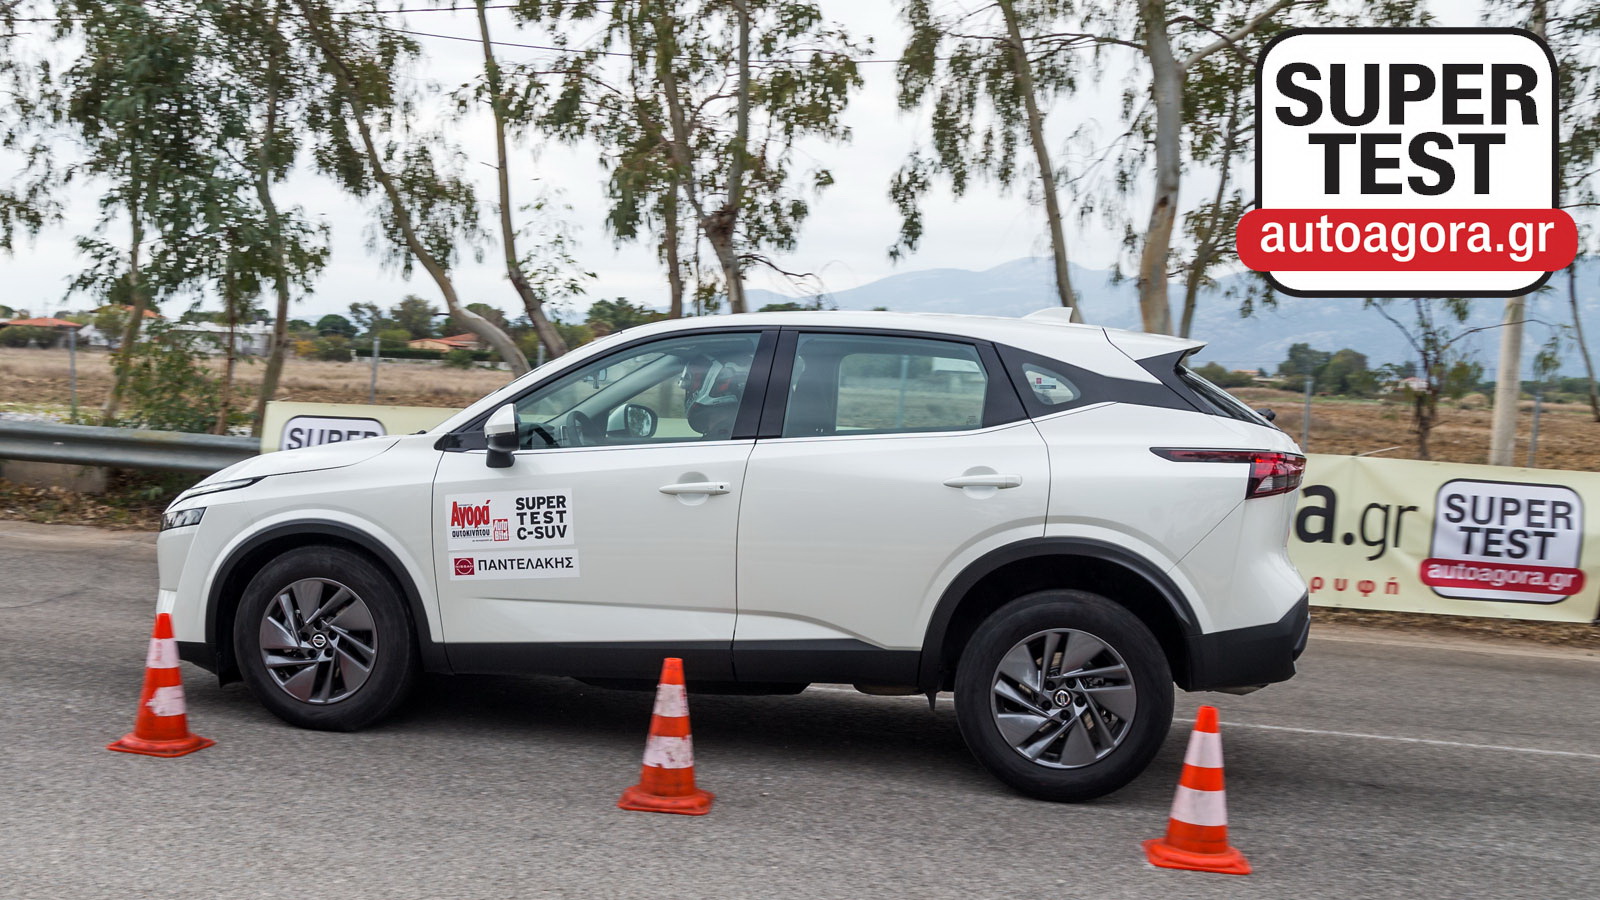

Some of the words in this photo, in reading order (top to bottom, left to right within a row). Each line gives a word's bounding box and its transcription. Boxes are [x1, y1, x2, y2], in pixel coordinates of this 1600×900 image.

[288, 427, 379, 450] SUP
[515, 496, 567, 511] SUPER
[1445, 493, 1573, 530] SUPER
[517, 510, 567, 525] TEST
[517, 525, 568, 540] C-SUV
[1460, 526, 1557, 560] TEST
[478, 557, 574, 571] ΠΑΝΤΕΛΑΚΗΣ
[1427, 562, 1578, 590] autoagora.gr
